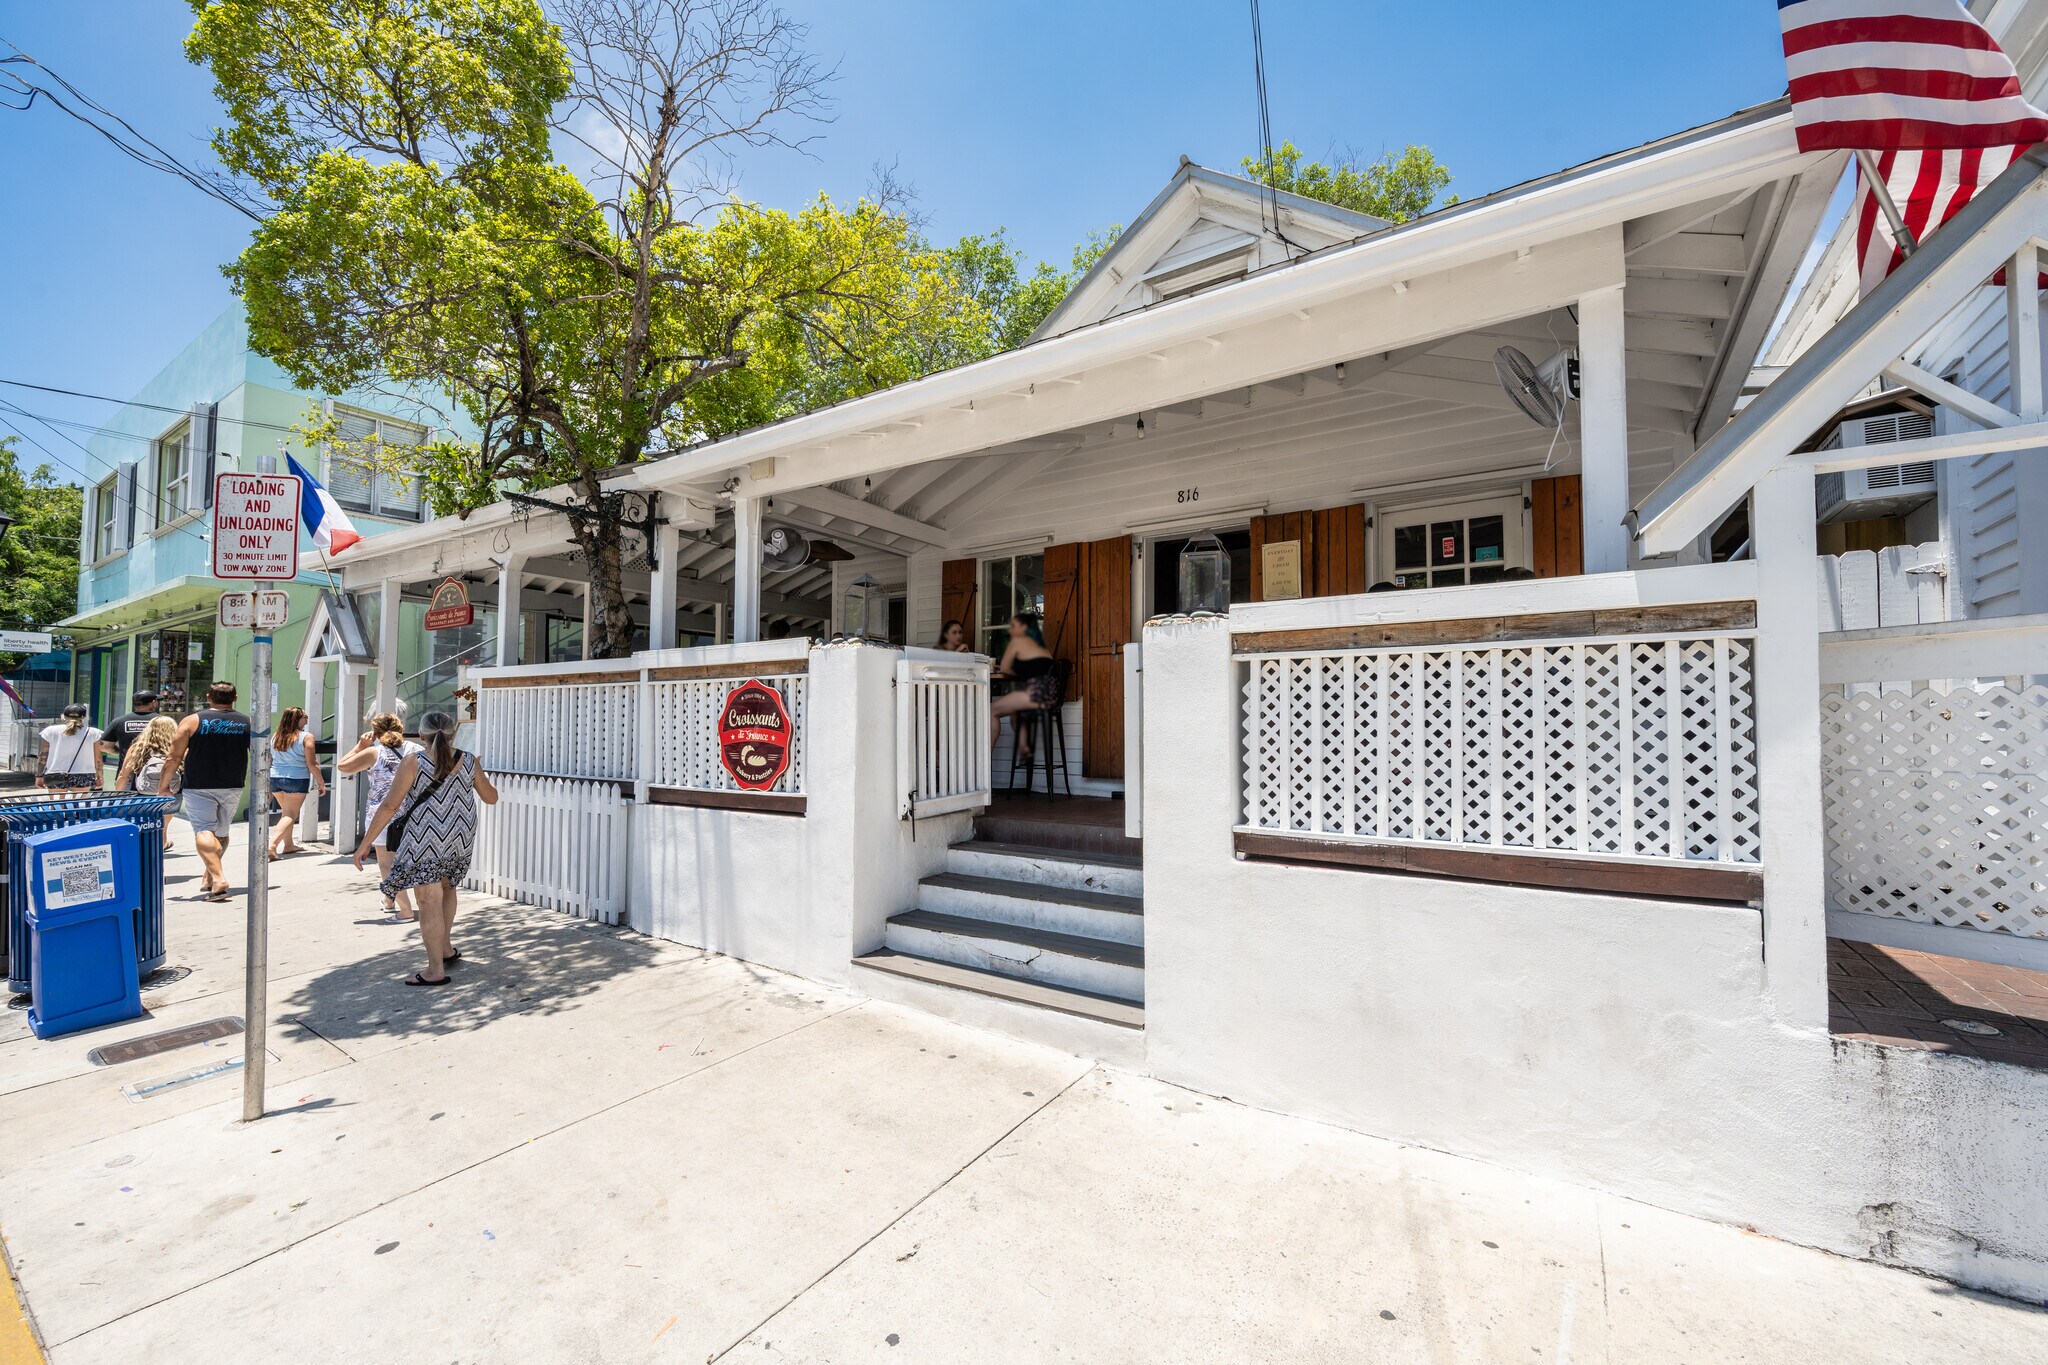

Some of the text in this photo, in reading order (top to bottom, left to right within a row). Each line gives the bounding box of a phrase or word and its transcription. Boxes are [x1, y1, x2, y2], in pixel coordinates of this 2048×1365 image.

[231, 480, 285, 496] LOADING
[1177, 486, 1199, 503] 816
[244, 499, 271, 513] AND
[219, 516, 293, 532] UNLOADING
[239, 534, 272, 549] ONLY
[222, 552, 288, 561] 30 MINUTE LIMIT
[223, 564, 287, 573] TOW AWAY ZONE
[728, 708, 781, 728] Croissants
[735, 766, 751, 781] Bakery
[755, 767, 773, 781] Pastries
[78, 854, 107, 862] EVENTS
